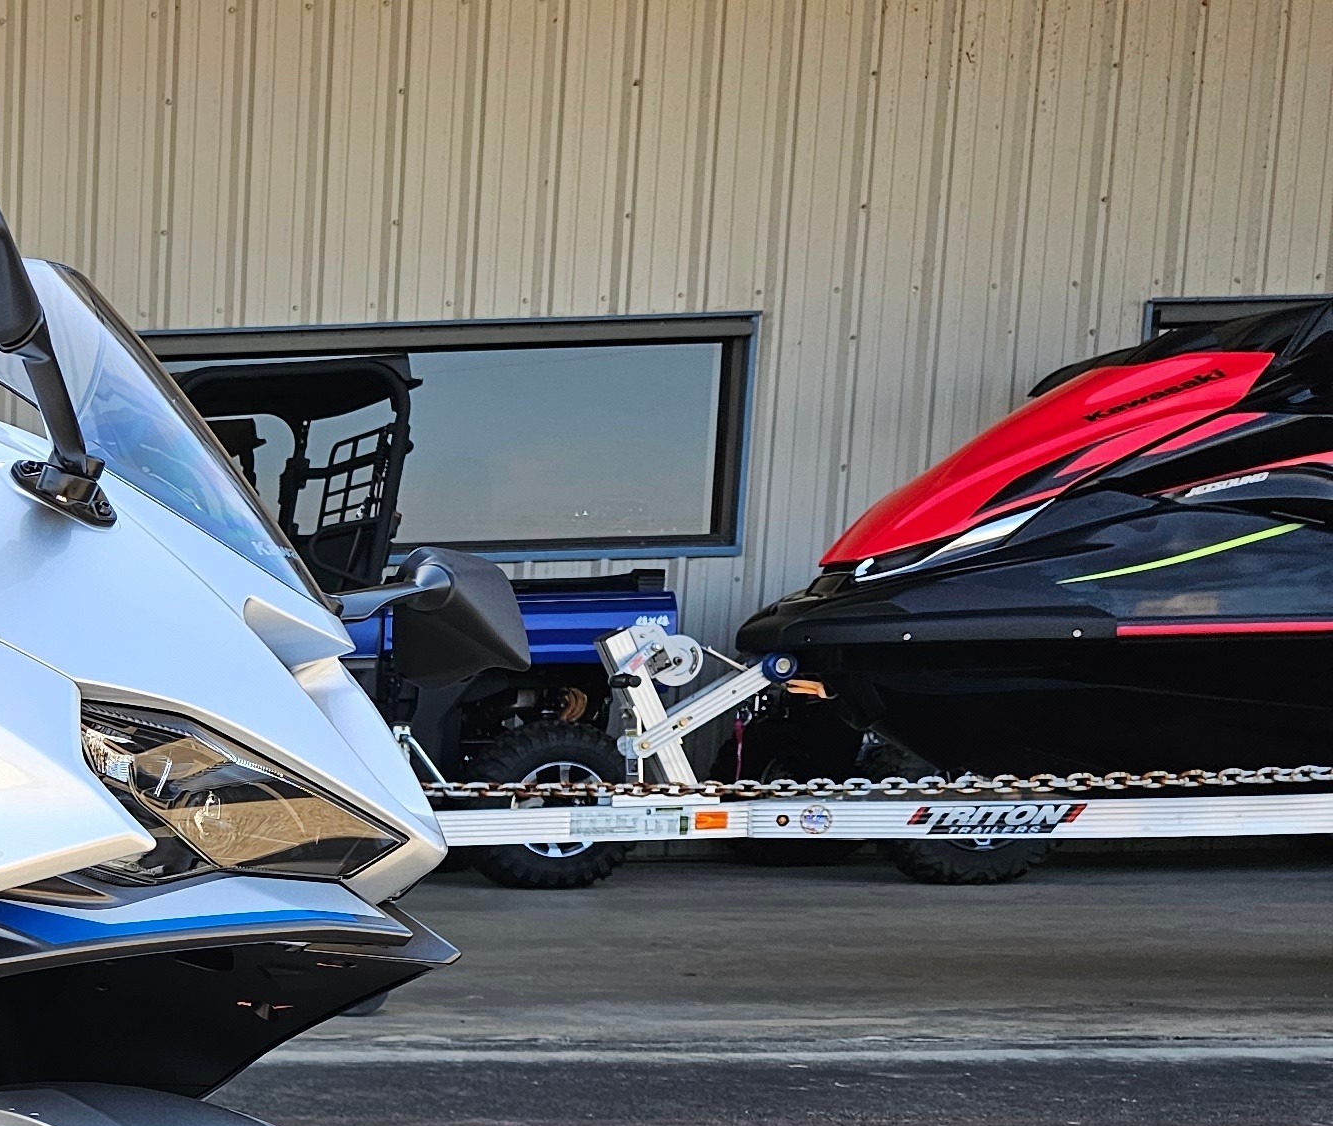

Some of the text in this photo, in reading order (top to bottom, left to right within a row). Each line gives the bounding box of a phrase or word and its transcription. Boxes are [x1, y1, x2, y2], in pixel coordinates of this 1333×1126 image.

[1083, 368, 1227, 422] Kawasaki
[925, 803, 1071, 826] TRITON
[947, 825, 1042, 835] TRAILERS
